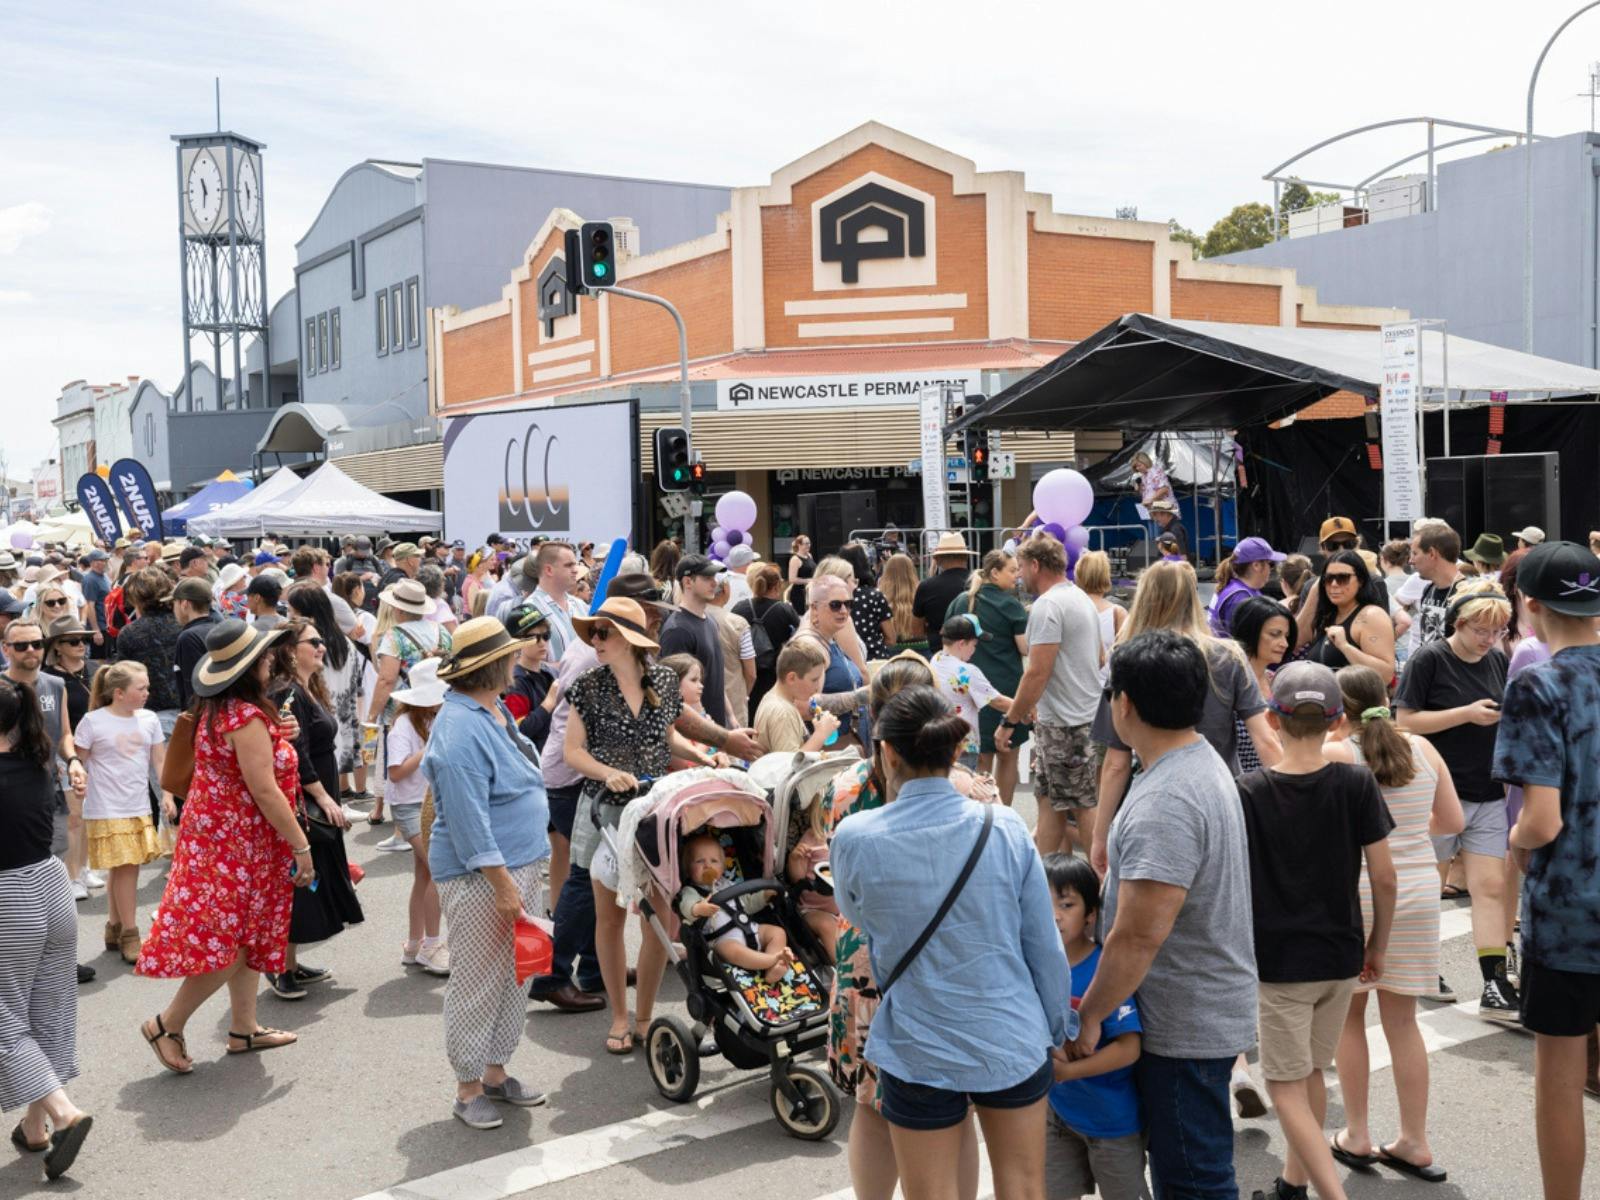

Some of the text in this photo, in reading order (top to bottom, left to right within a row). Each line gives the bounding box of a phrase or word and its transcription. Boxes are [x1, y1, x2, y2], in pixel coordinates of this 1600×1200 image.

[758, 383, 859, 400] NEWCASTLE
[864, 379, 968, 396] PERMA
[802, 466, 890, 480] NEWCASTLE
[84, 485, 117, 541] 2NUR
[119, 473, 154, 537] 2NUR
